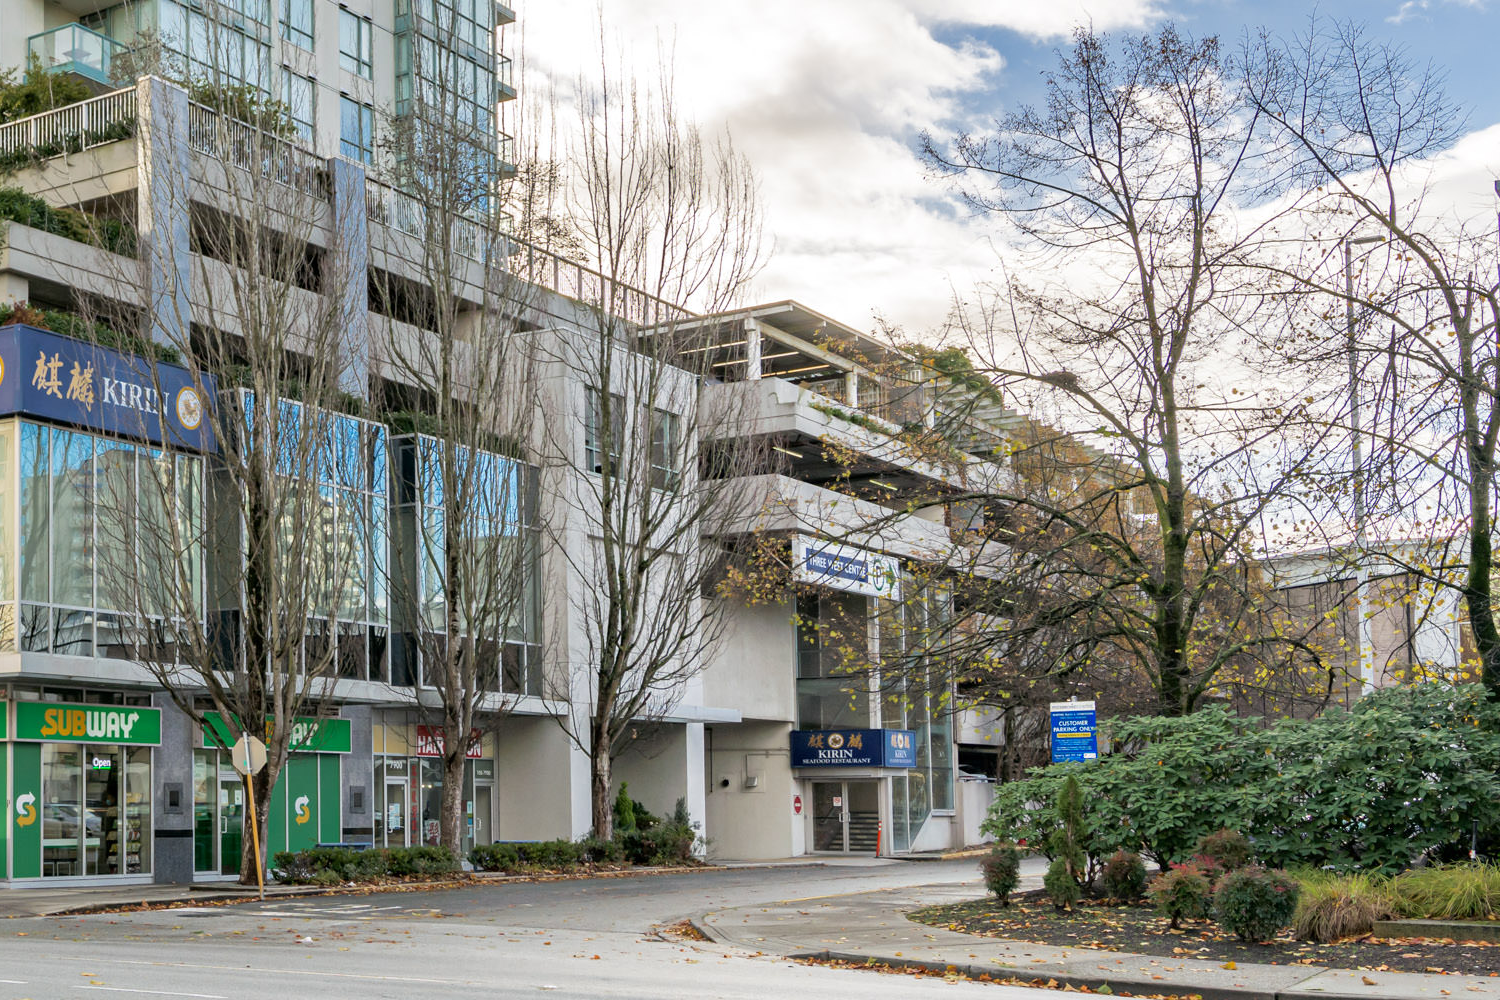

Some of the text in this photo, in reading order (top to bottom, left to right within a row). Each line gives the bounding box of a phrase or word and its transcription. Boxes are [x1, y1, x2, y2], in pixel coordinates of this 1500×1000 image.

[103, 377, 170, 417] KIRIN
[40, 708, 139, 738] SUBWAY
[418, 735, 444, 755] HAIR
[818, 749, 853, 759] KIRIN
[92, 757, 111, 768] Open
